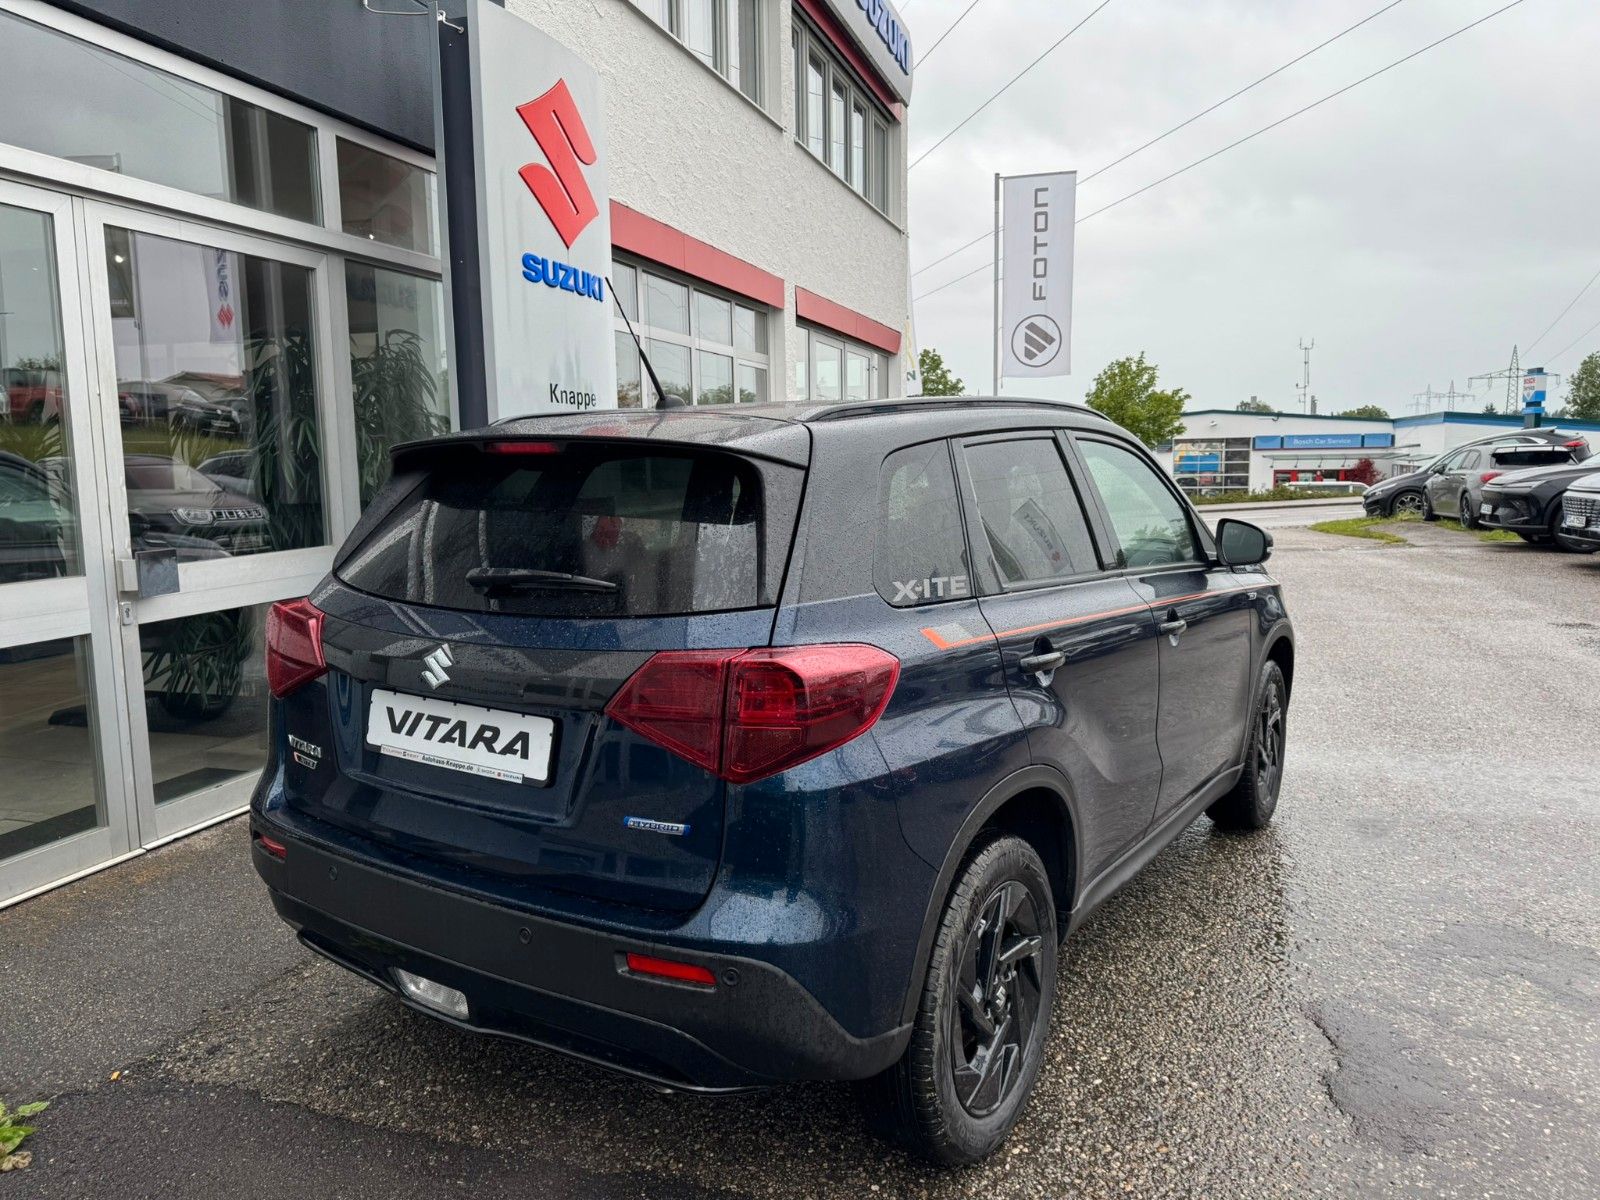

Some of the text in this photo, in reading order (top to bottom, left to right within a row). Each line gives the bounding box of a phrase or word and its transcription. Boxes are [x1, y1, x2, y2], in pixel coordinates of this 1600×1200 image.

[855, 0, 909, 75] UZUKI
[1033, 187, 1048, 300] FOTON
[522, 252, 603, 302] SUZUKI
[550, 383, 596, 410] Knappe
[892, 575, 967, 601] X-ITE
[288, 734, 322, 758] VITARA
[386, 706, 530, 760] VITARA
[629, 819, 681, 832] HYBRID
